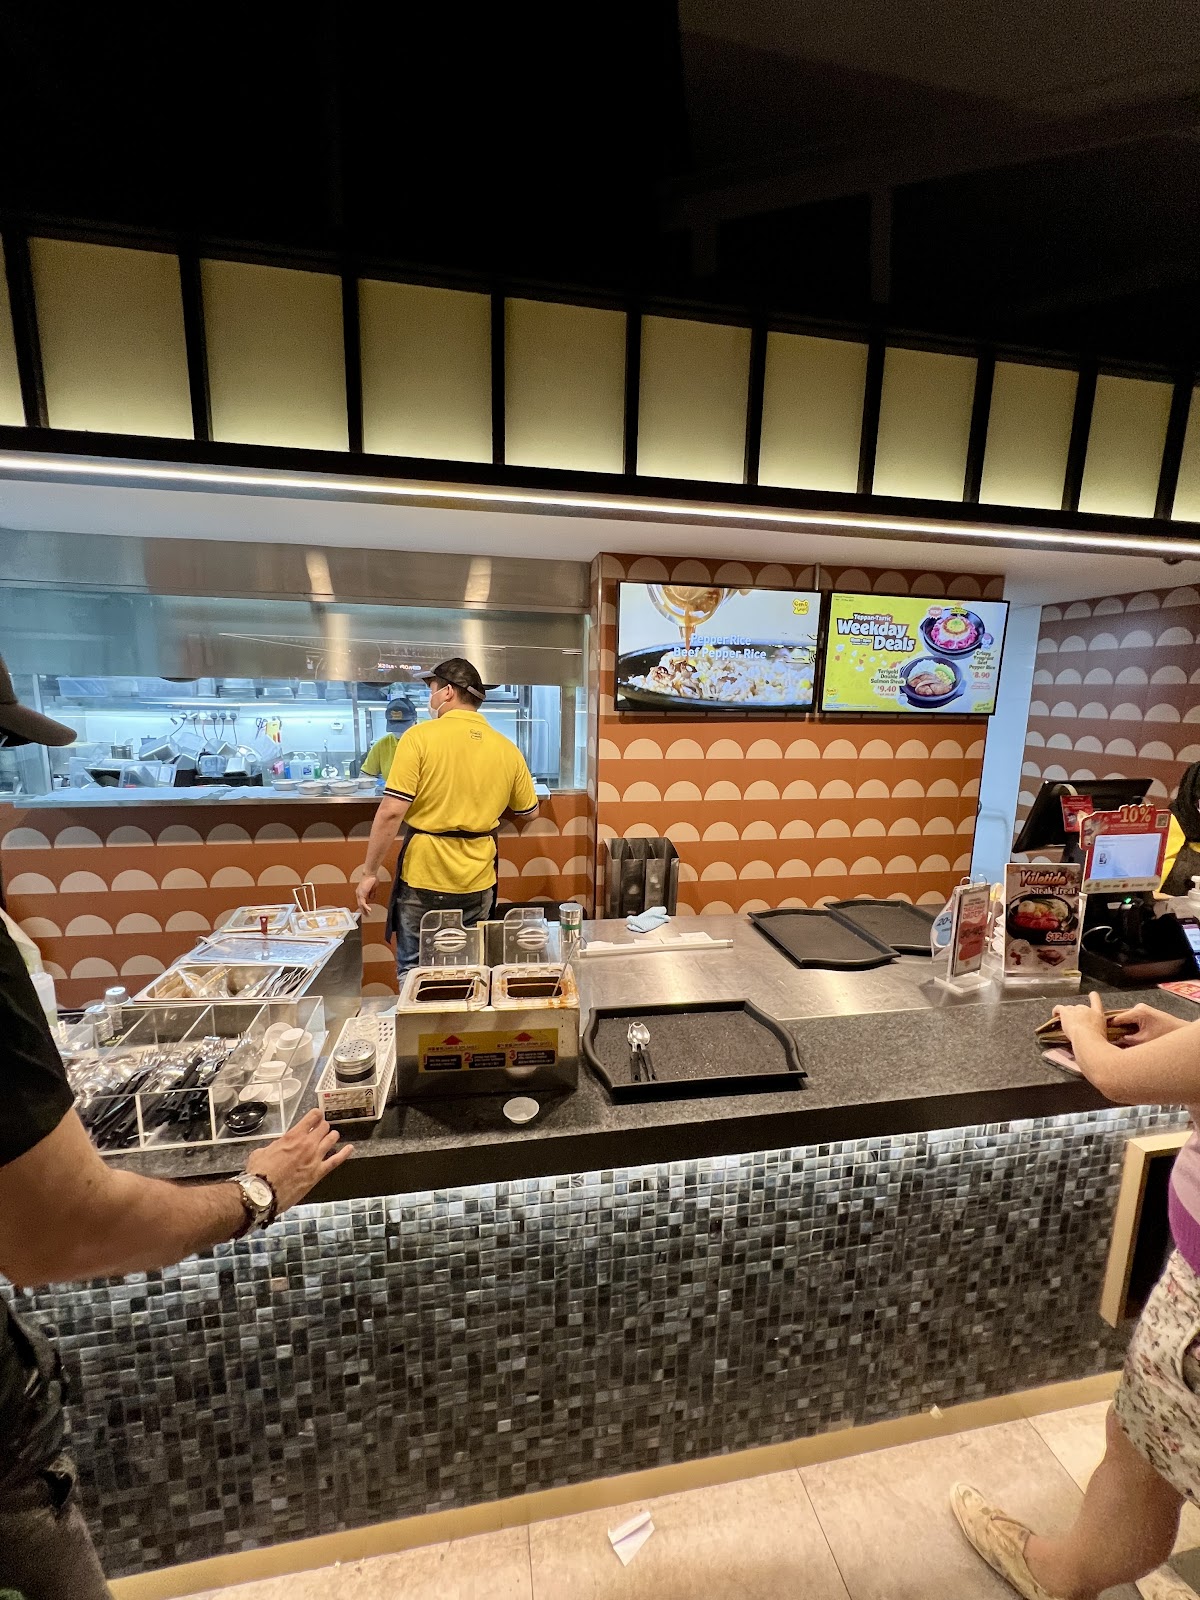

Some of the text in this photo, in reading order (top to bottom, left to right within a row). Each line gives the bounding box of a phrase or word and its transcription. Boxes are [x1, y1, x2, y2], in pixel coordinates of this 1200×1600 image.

[838, 619, 908, 638] Weekday
[690, 633, 752, 646] Pepper Rice
[873, 635, 915, 651] Deals
[673, 646, 767, 660] Beef Pepper Rice
[1120, 807, 1152, 822] 10%
[1030, 886, 1053, 894] Steak
[464, 1052, 472, 1062] 2
[509, 1049, 517, 1060] 3
